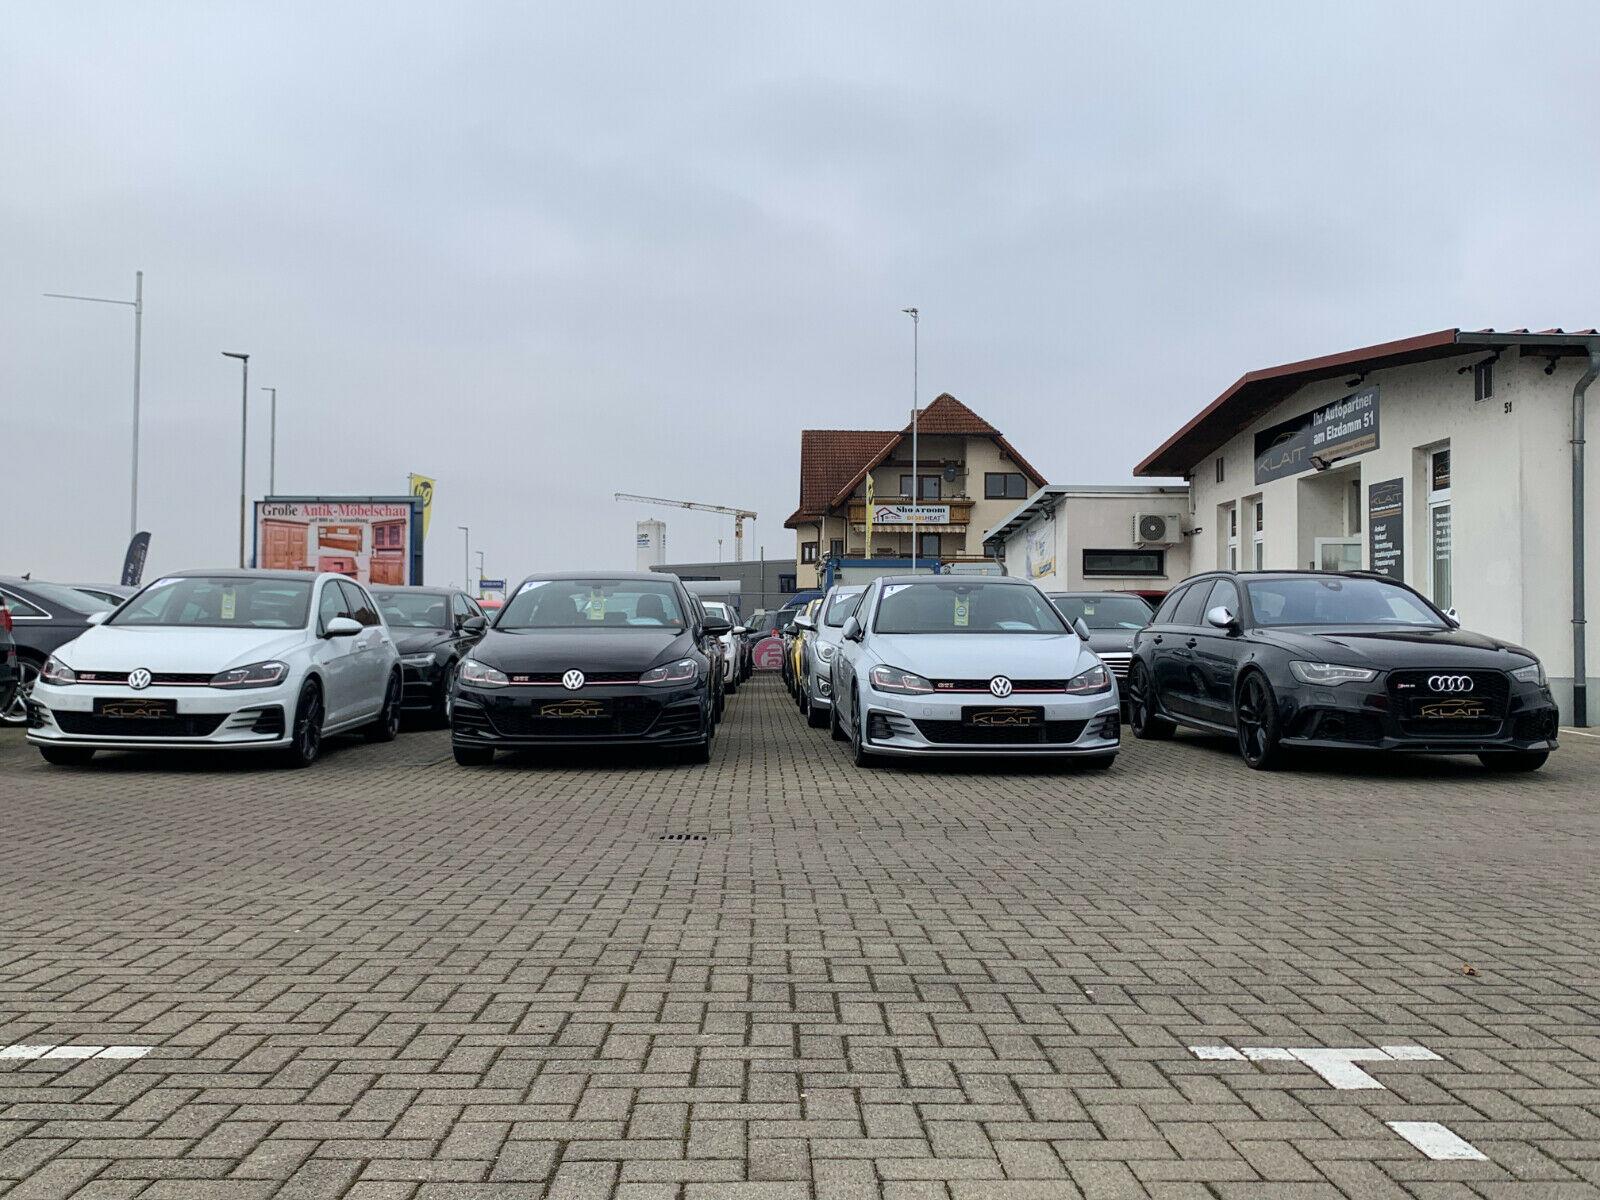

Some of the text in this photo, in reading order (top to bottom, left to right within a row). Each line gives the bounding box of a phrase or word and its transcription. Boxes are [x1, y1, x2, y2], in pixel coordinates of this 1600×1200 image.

[1313, 394, 1373, 426] Ihr Autopartner
[1504, 401, 1512, 414] 51
[1313, 410, 1374, 445] am Elzdamm 51
[1257, 446, 1306, 474] KLAIT
[262, 503, 406, 517] Große Antik-Möbelschau
[102, 707, 168, 717] KLAIT
[540, 706, 604, 716] KLAIT
[1421, 707, 1485, 717] KLAIT
[973, 714, 1038, 724] KLAIT
